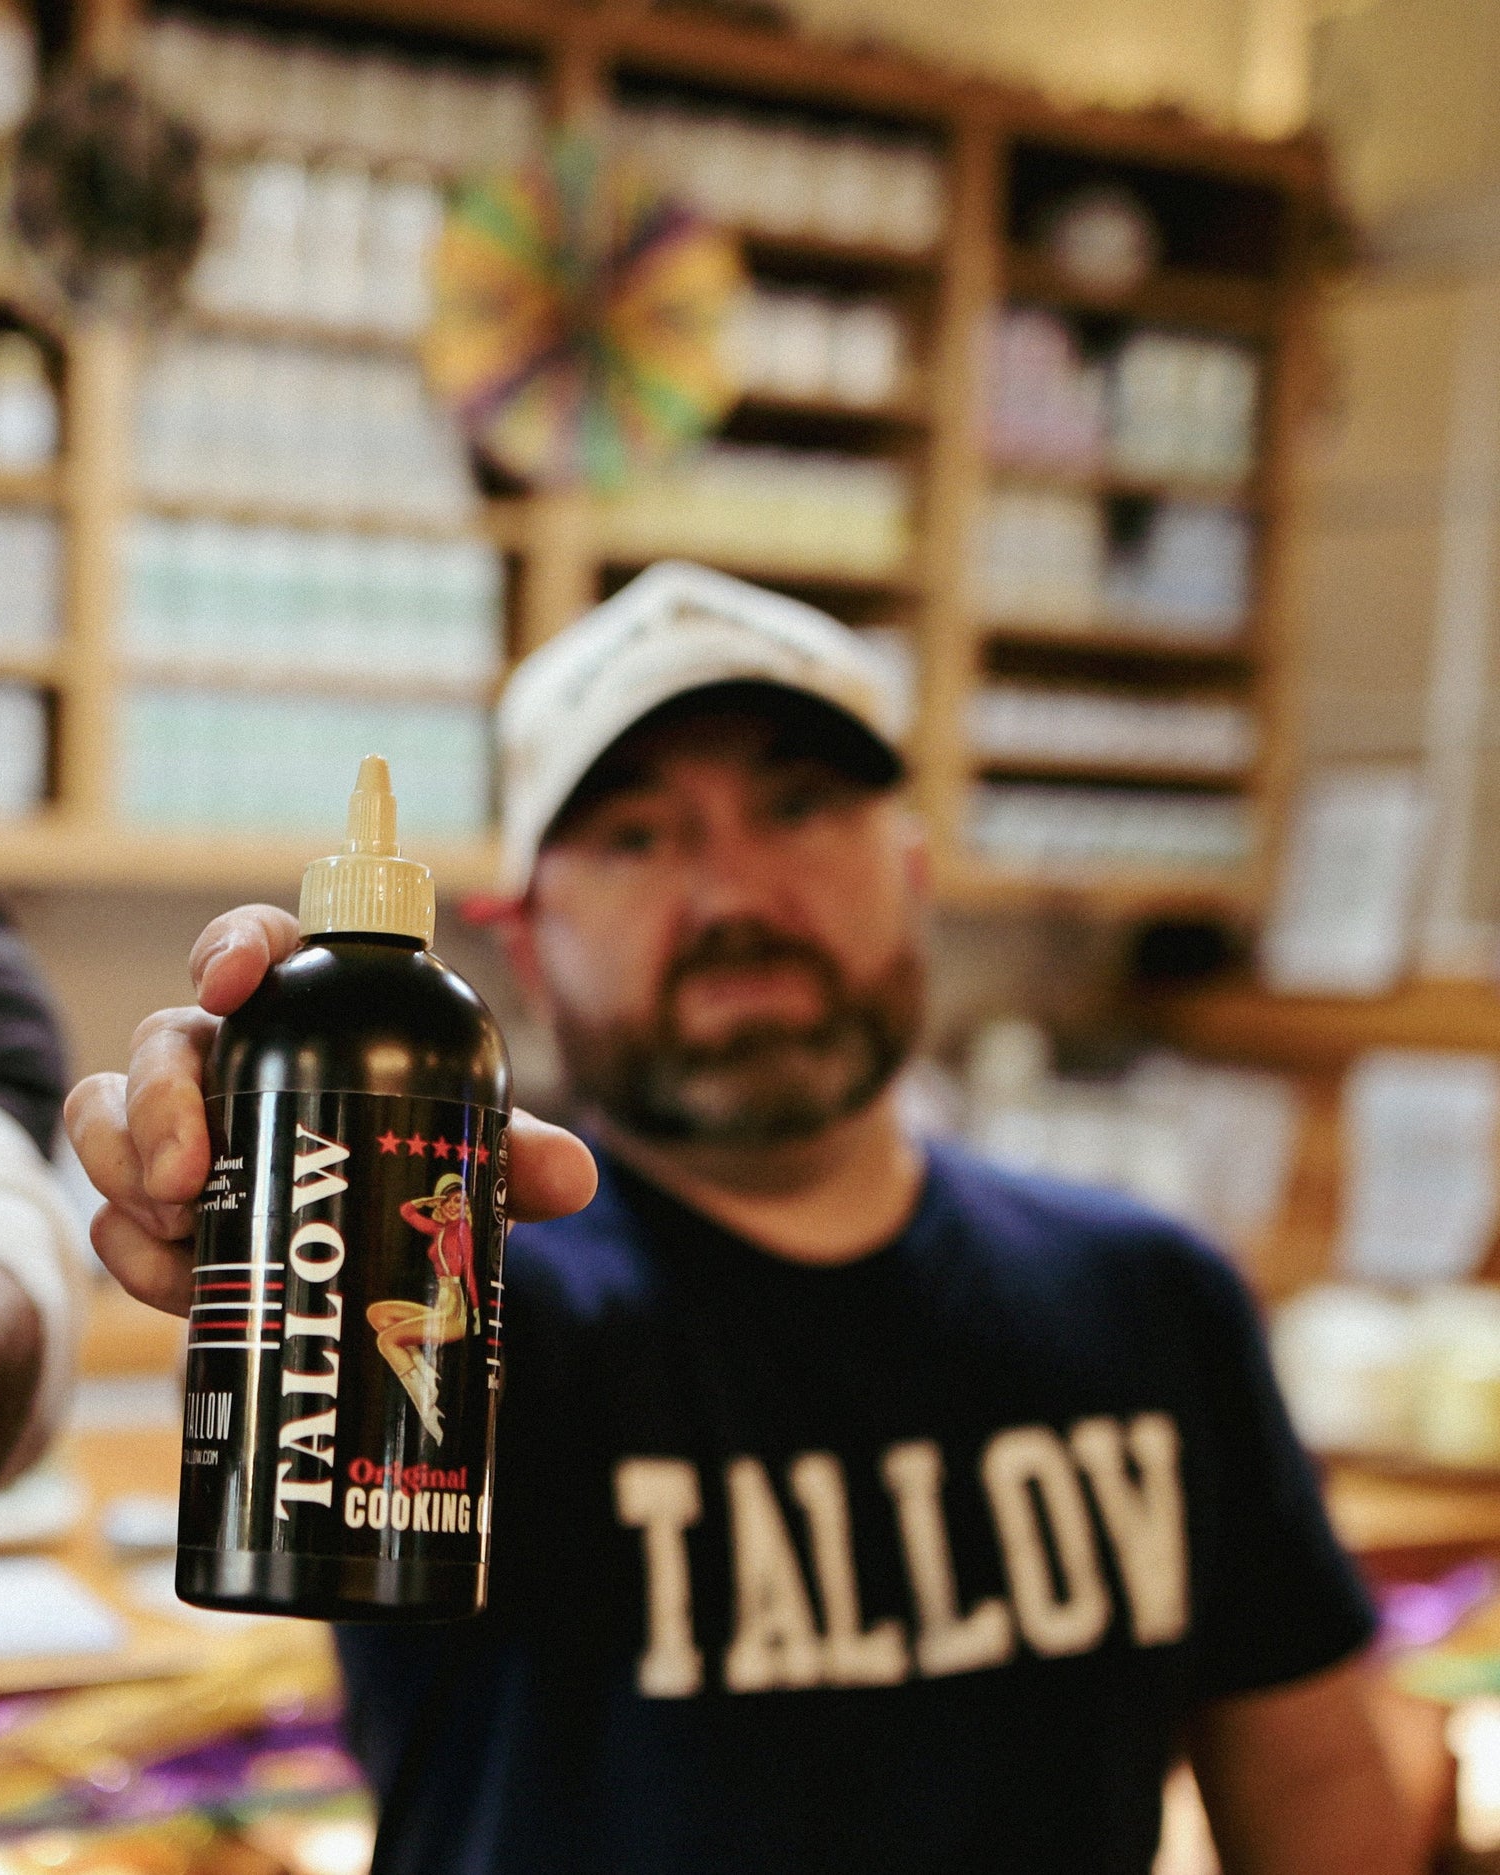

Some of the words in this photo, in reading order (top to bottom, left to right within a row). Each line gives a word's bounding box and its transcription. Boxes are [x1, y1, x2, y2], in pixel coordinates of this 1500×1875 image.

[206, 1174, 231, 1191] amily
[214, 1155, 244, 1171] about
[275, 1123, 351, 1522] TALLOW
[349, 1457, 469, 1498] Original
[344, 1486, 472, 1535] COOKING
[613, 1410, 1190, 1700] TALLOW
